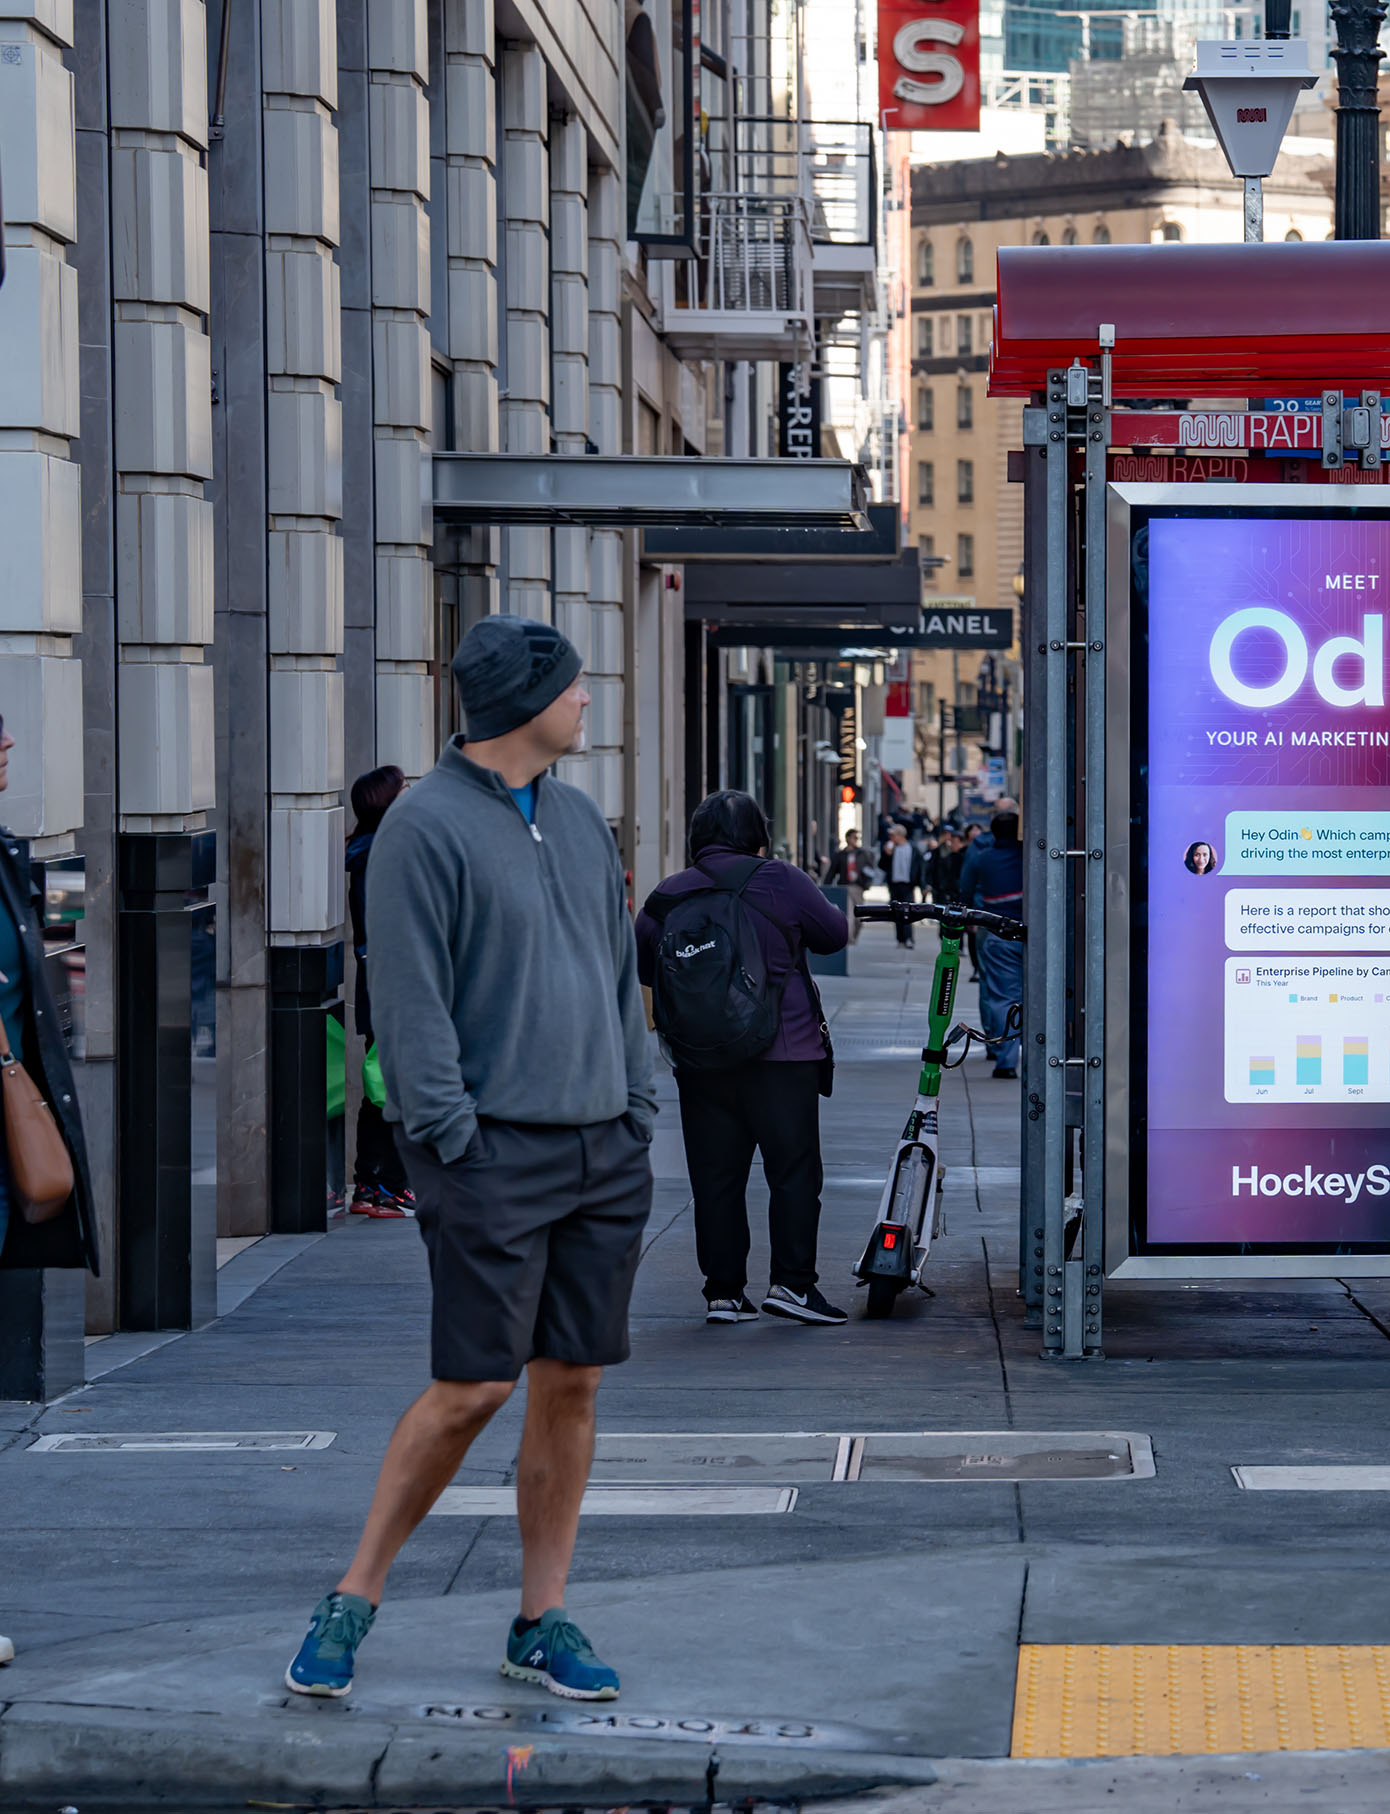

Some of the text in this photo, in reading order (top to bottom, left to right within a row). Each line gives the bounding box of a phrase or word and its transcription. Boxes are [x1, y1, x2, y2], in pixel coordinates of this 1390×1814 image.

[1250, 415, 1322, 448] RAPI
[1172, 457, 1248, 483] RAPID
[1325, 575, 1380, 590] MEET
[890, 616, 998, 634] ANEL
[1205, 731, 1258, 746] YOUR
[1264, 732, 1284, 746] AI
[1241, 829, 1266, 842] Hey
[1268, 829, 1299, 841] Odin
[1316, 829, 1356, 841] Which
[1240, 848, 1285, 861] driving
[1288, 848, 1309, 859] the
[1311, 849, 1343, 859] most
[1240, 904, 1271, 916] Here
[1273, 904, 1284, 916] is
[1287, 907, 1294, 916] a
[1298, 905, 1337, 918] report
[1340, 905, 1366, 916] that
[1240, 923, 1295, 935] effective
[1297, 923, 1366, 937] campaigns
[1368, 923, 1386, 935] for
[1256, 967, 1310, 978] Enterprise
[1312, 967, 1354, 978] Pipeline
[1356, 967, 1369, 978] by
[423, 1705, 815, 1738] STOCKTON
